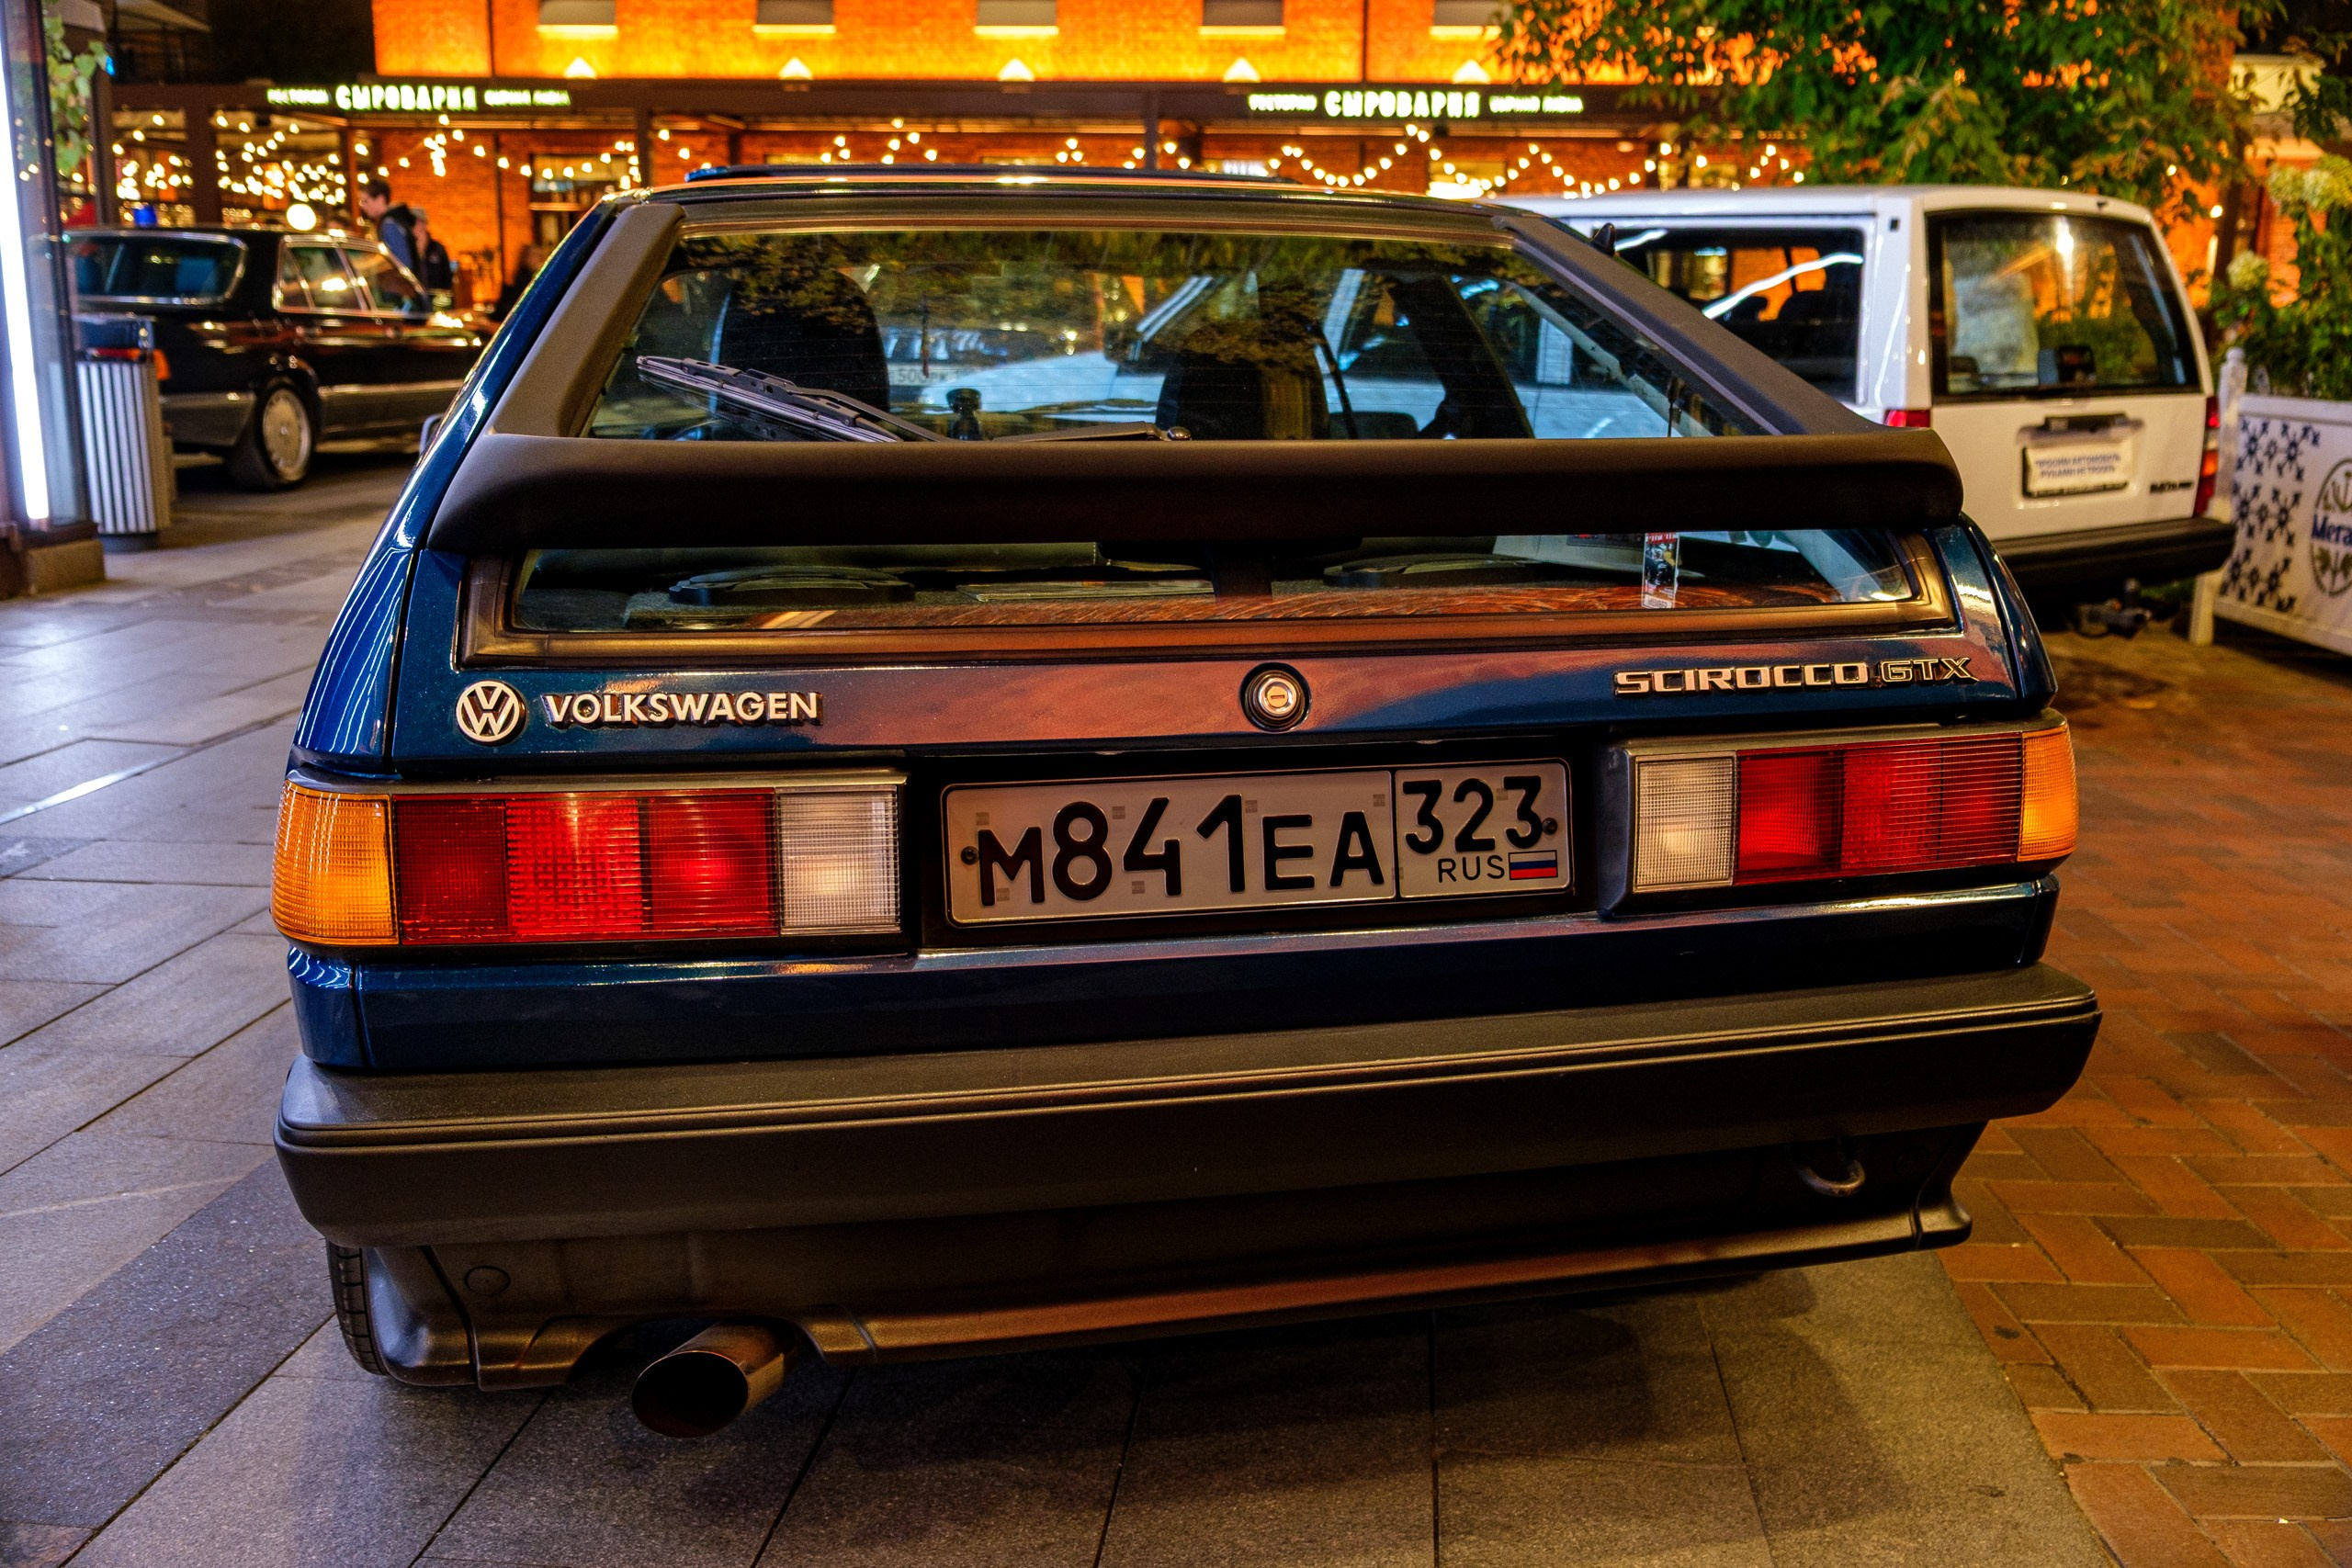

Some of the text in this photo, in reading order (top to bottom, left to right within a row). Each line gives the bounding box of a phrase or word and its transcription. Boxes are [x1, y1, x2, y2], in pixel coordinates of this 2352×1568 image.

[335, 85, 477, 110] СЫРОВАРНЯ
[1324, 90, 1480, 118] СЫРОВАРНЯ
[1615, 656, 1980, 696] SCIROCCO GTX
[543, 692, 820, 726] VOLKSWAGEN
[1403, 775, 1544, 854] 323
[1438, 854, 1506, 884] RUS
